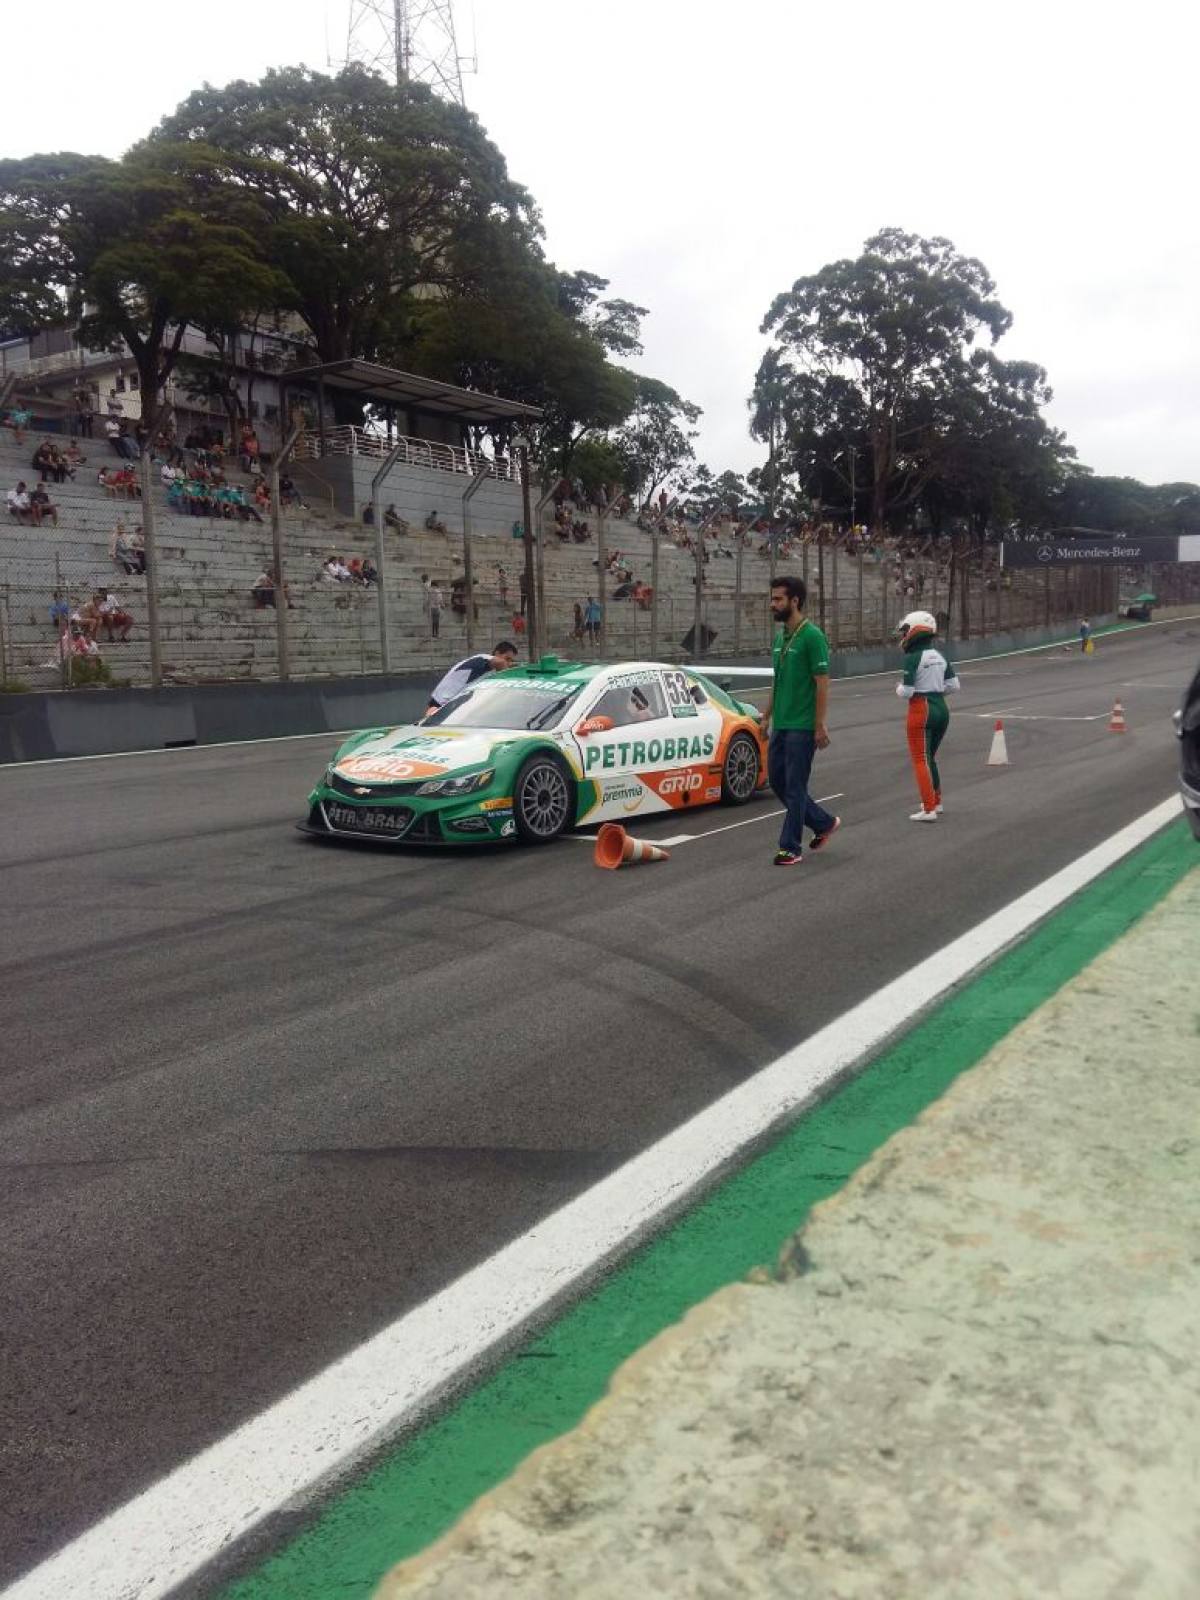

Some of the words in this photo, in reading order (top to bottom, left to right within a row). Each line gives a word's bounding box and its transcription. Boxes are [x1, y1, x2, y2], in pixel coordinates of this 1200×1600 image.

[1056, 546, 1141, 559] Mercedes-Benz
[663, 672, 692, 704] 53
[585, 733, 714, 771] PETROBRAS
[350, 757, 416, 776] GRID
[659, 772, 703, 794] GRID
[601, 786, 643, 807] premmia
